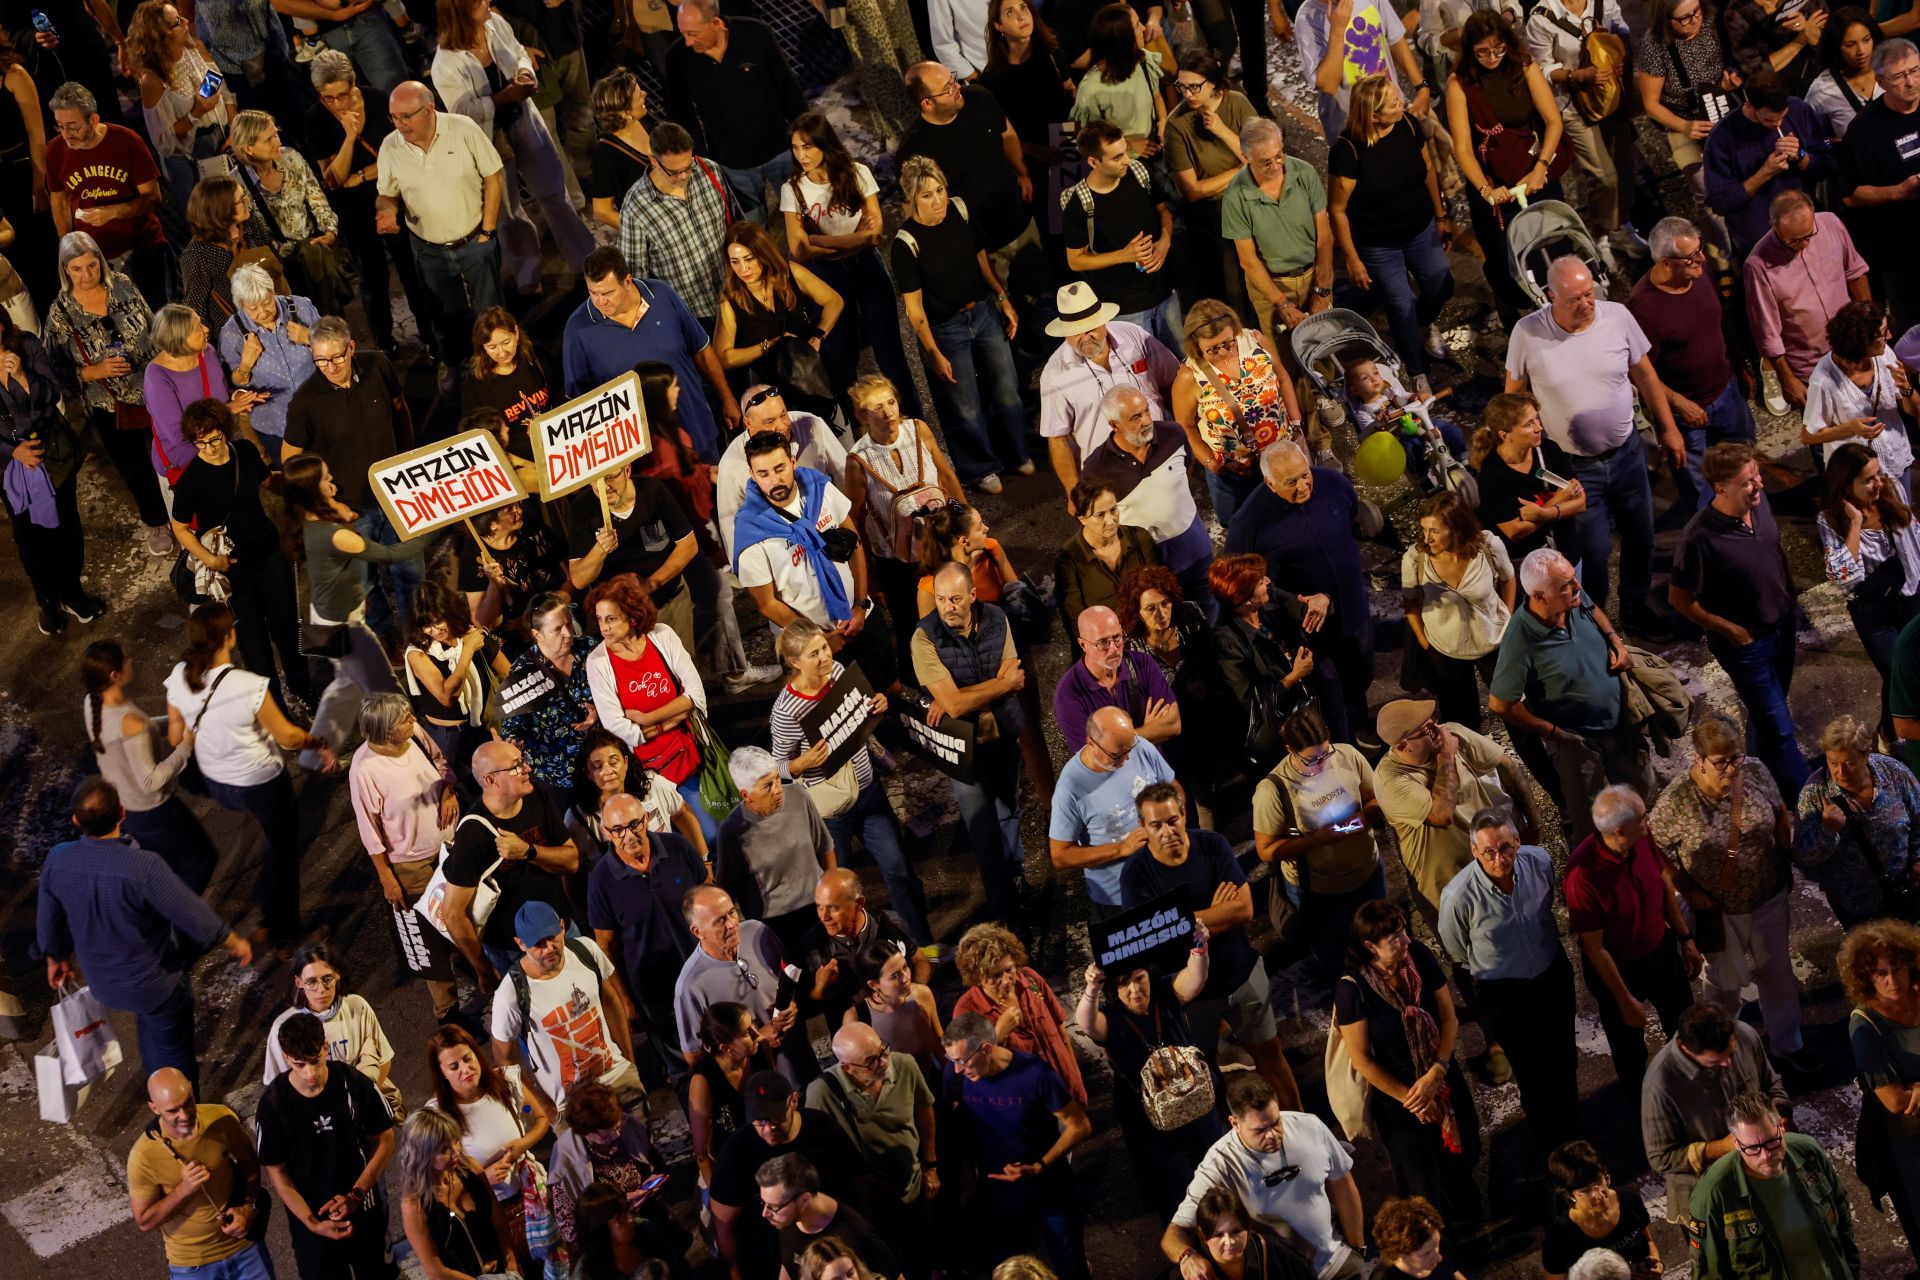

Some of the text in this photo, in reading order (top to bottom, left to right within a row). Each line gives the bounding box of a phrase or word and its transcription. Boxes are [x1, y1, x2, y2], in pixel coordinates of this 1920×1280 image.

[66, 164, 128, 190] LOS ANGELES
[81, 187, 118, 199] California
[547, 389, 631, 446] MAZÓN
[382, 442, 490, 494] MAZÓN
[501, 670, 545, 700] MAZÓN
[502, 677, 555, 714] DIMISSIÓ
[819, 687, 863, 739] MAZÓN
[1311, 786, 1346, 808] PAIPORTA
[401, 909, 432, 968] MAZÓN
[1101, 917, 1191, 966] DIMISSIÓ
[1107, 907, 1179, 948] MAZÓN
